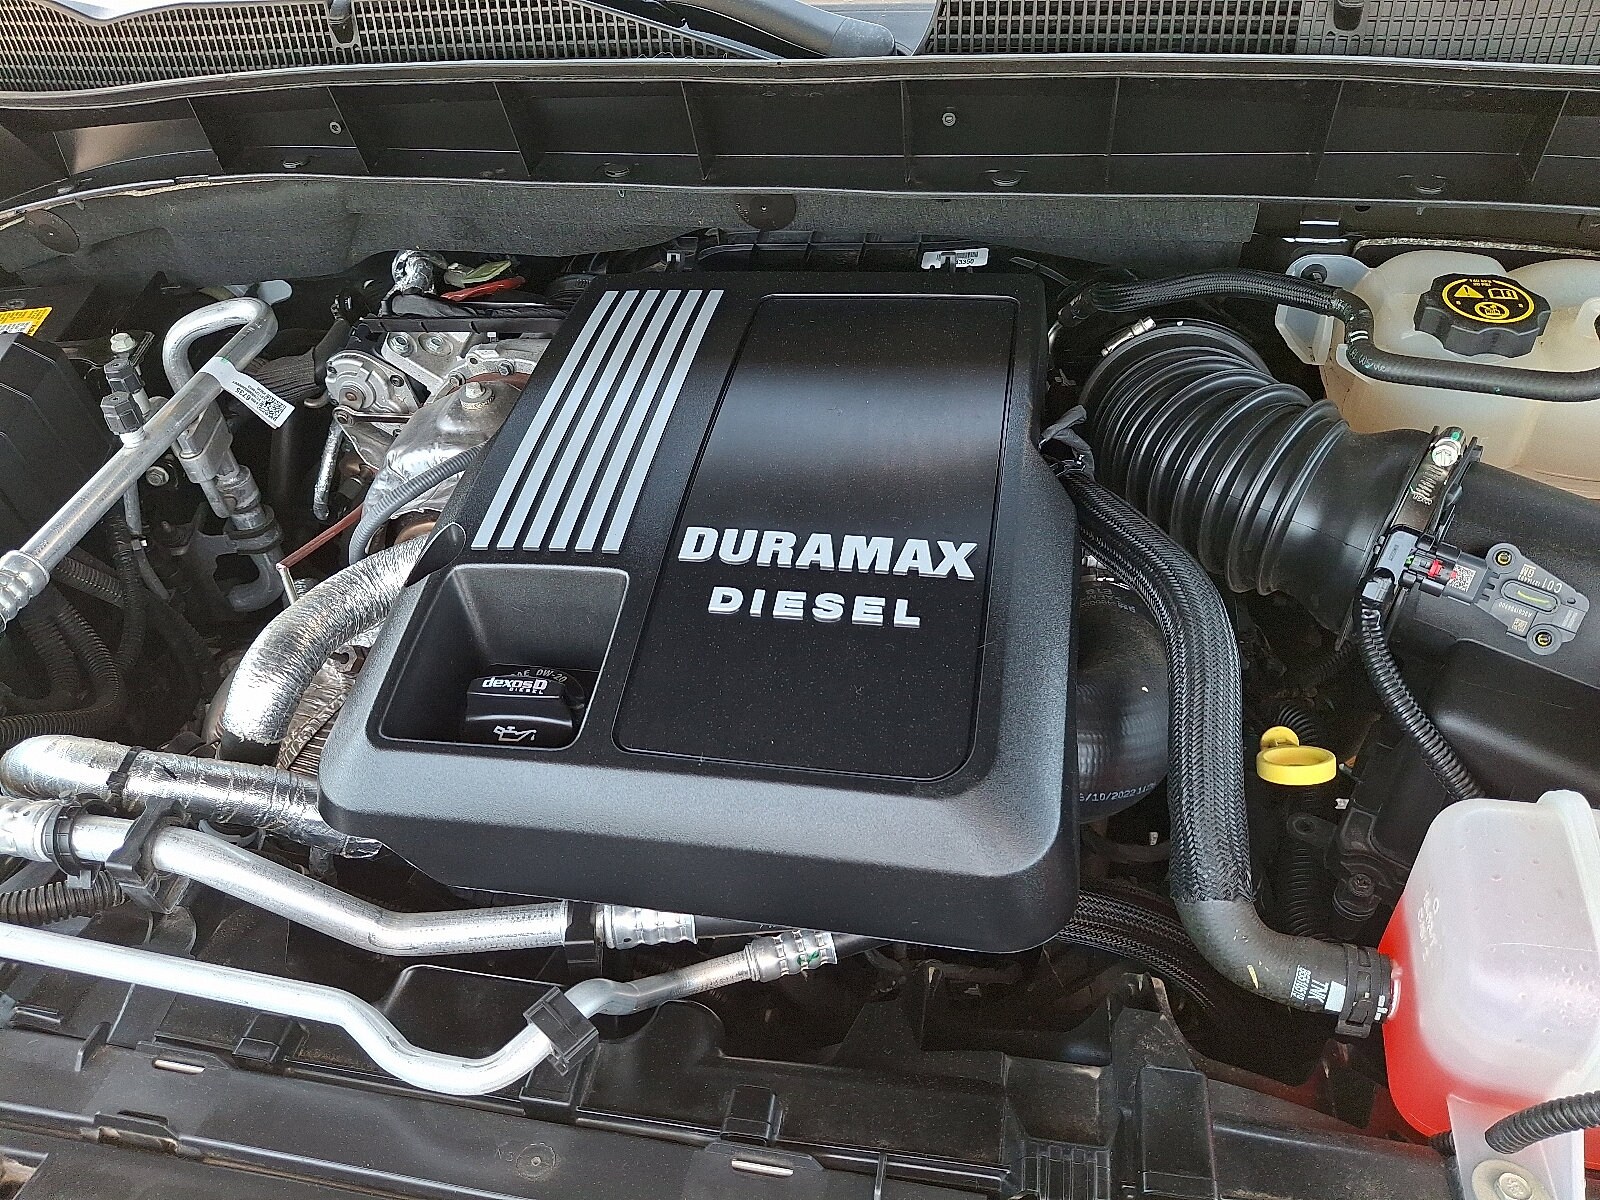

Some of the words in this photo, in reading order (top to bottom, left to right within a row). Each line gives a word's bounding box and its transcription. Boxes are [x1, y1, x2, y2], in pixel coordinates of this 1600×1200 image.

[234, 387, 251, 401] 6735
[678, 526, 977, 581] DURAMAX
[1541, 577, 1563, 594] C01
[708, 586, 920, 628] DIESEL
[1308, 979, 1330, 1004] TNK
